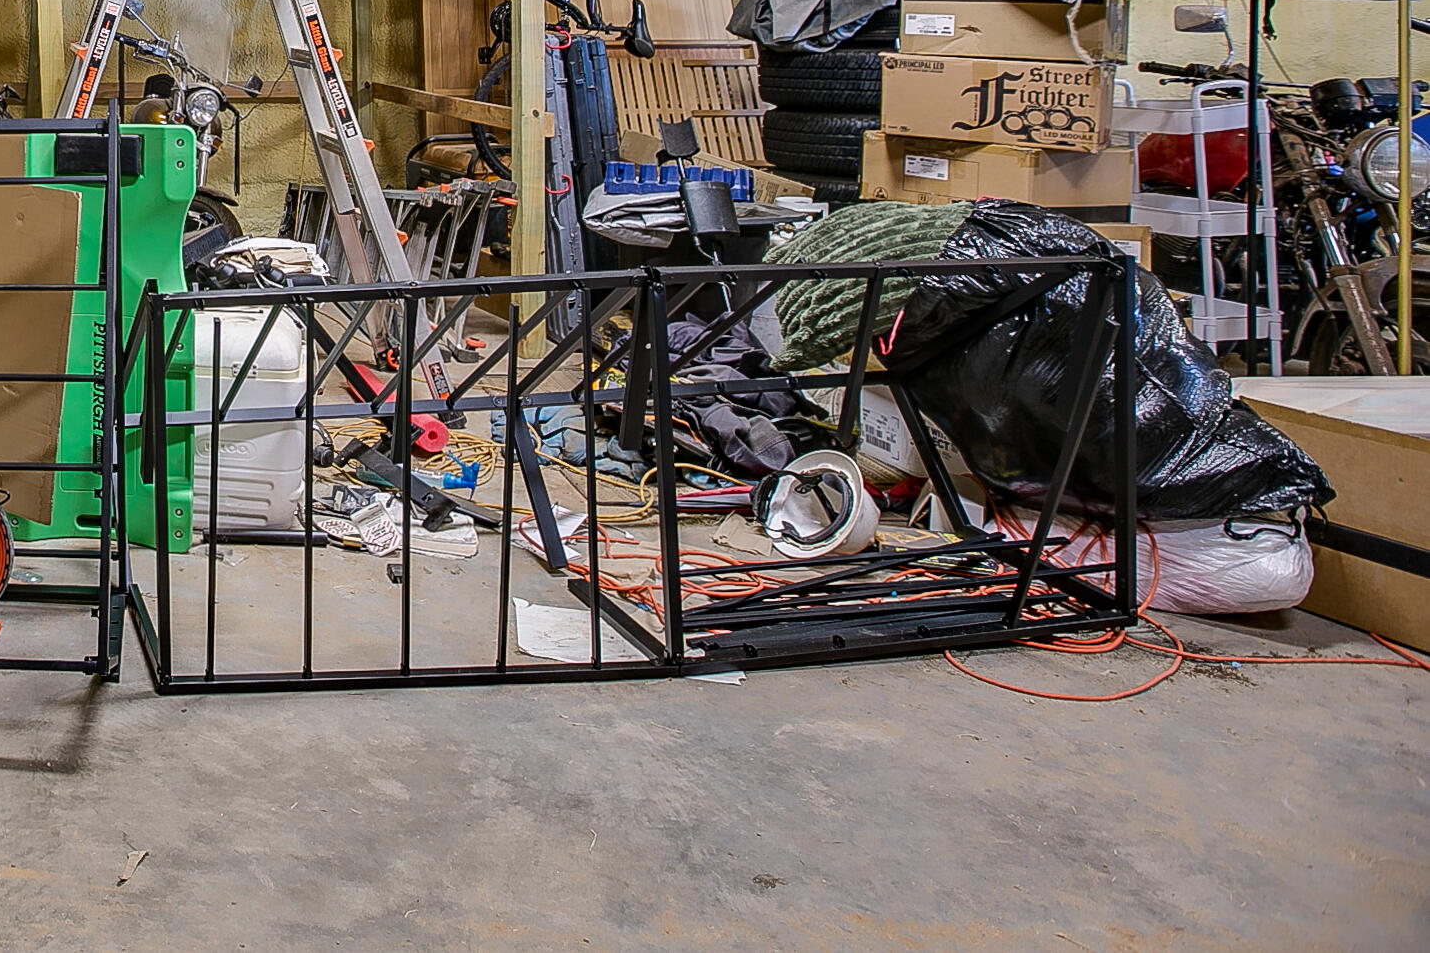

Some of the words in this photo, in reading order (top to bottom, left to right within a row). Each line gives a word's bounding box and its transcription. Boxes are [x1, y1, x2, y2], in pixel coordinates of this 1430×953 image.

[308, 18, 322, 47] Little
[316, 45, 332, 73] Giant
[899, 59, 931, 69] PRINCIPAL
[933, 61, 945, 69] LED
[73, 91, 89, 118] Little
[82, 65, 98, 92] Giant
[951, 72, 1091, 131] Fighter
[1029, 66, 1093, 86] Street
[1059, 132, 1094, 142] MODULE
[92, 321, 106, 435] PITTSURGH
